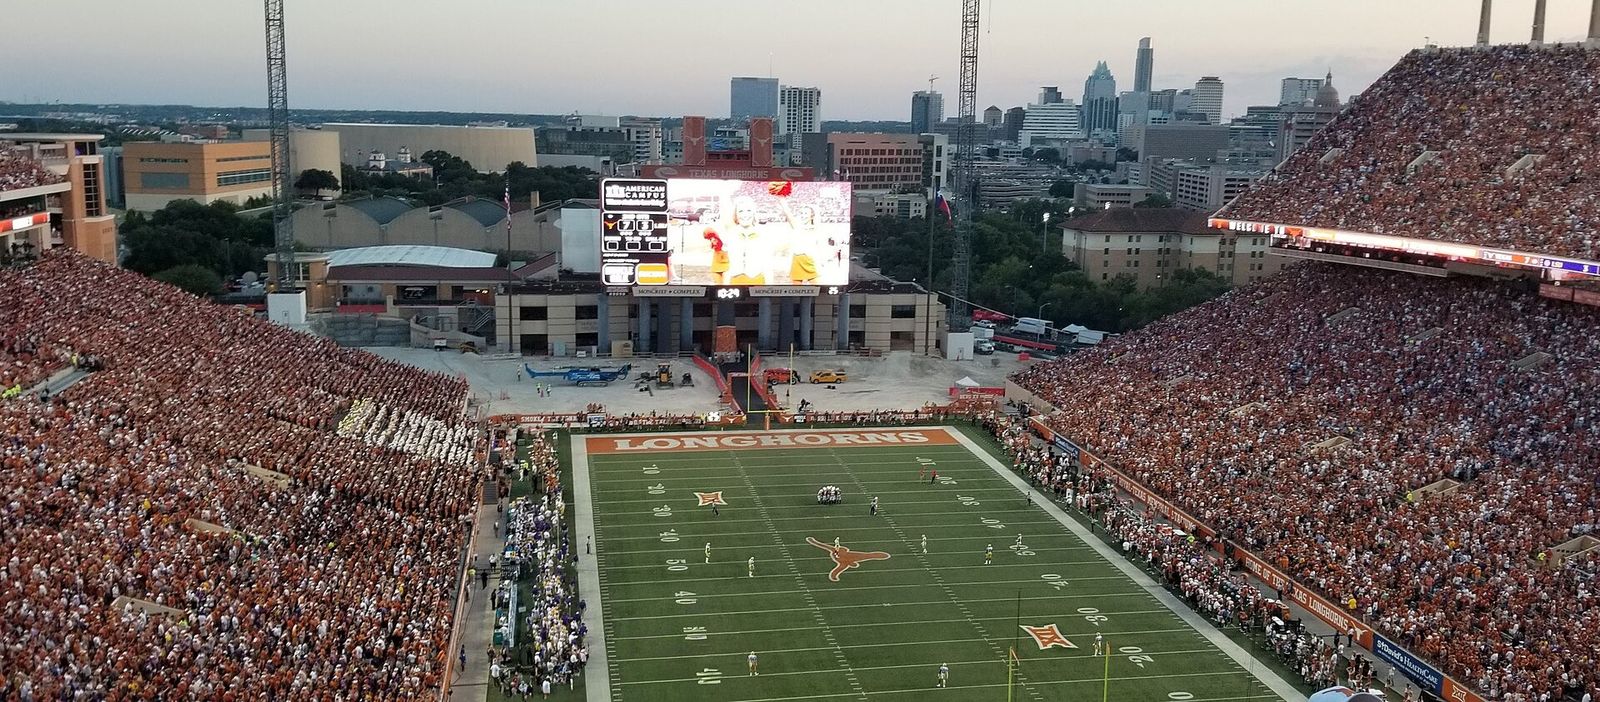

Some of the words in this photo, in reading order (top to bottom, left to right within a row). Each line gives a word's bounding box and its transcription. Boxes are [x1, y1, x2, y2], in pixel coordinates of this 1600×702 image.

[689, 169, 717, 178] TEXAS
[721, 170, 769, 179] LONGHORNS
[622, 221, 631, 230] 7
[614, 431, 929, 451] LONGHORNS
[666, 559, 688, 571] 50
[1041, 573, 1069, 589] 40
[1245, 556, 1262, 576] HOME
[1262, 568, 1271, 581] OF
[1309, 596, 1349, 631] LONGHORNS
[1077, 607, 1108, 623] 30
[1119, 646, 1154, 664] 20
